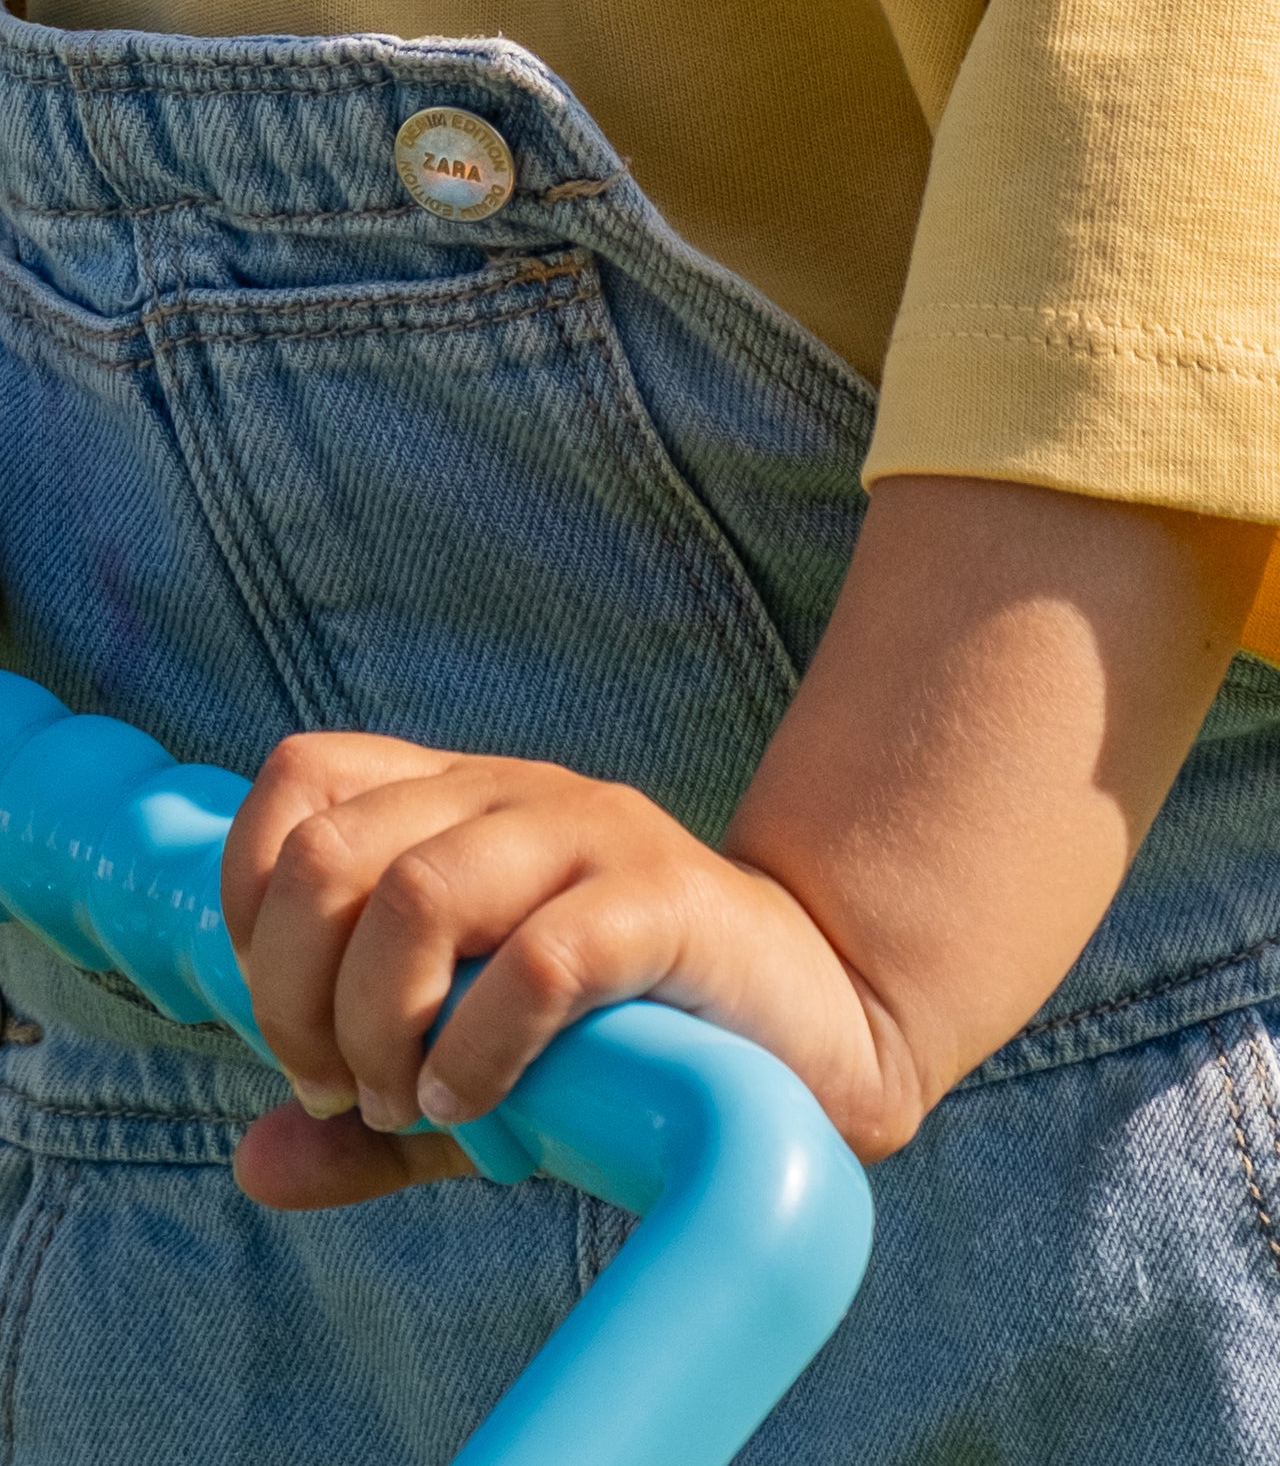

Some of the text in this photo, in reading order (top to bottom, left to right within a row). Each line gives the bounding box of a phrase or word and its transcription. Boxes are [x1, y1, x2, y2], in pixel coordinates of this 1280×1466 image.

[400, 113, 507, 173] DENIM EDITION
[422, 151, 481, 183] ZARA
[399, 160, 454, 217] EDITION
